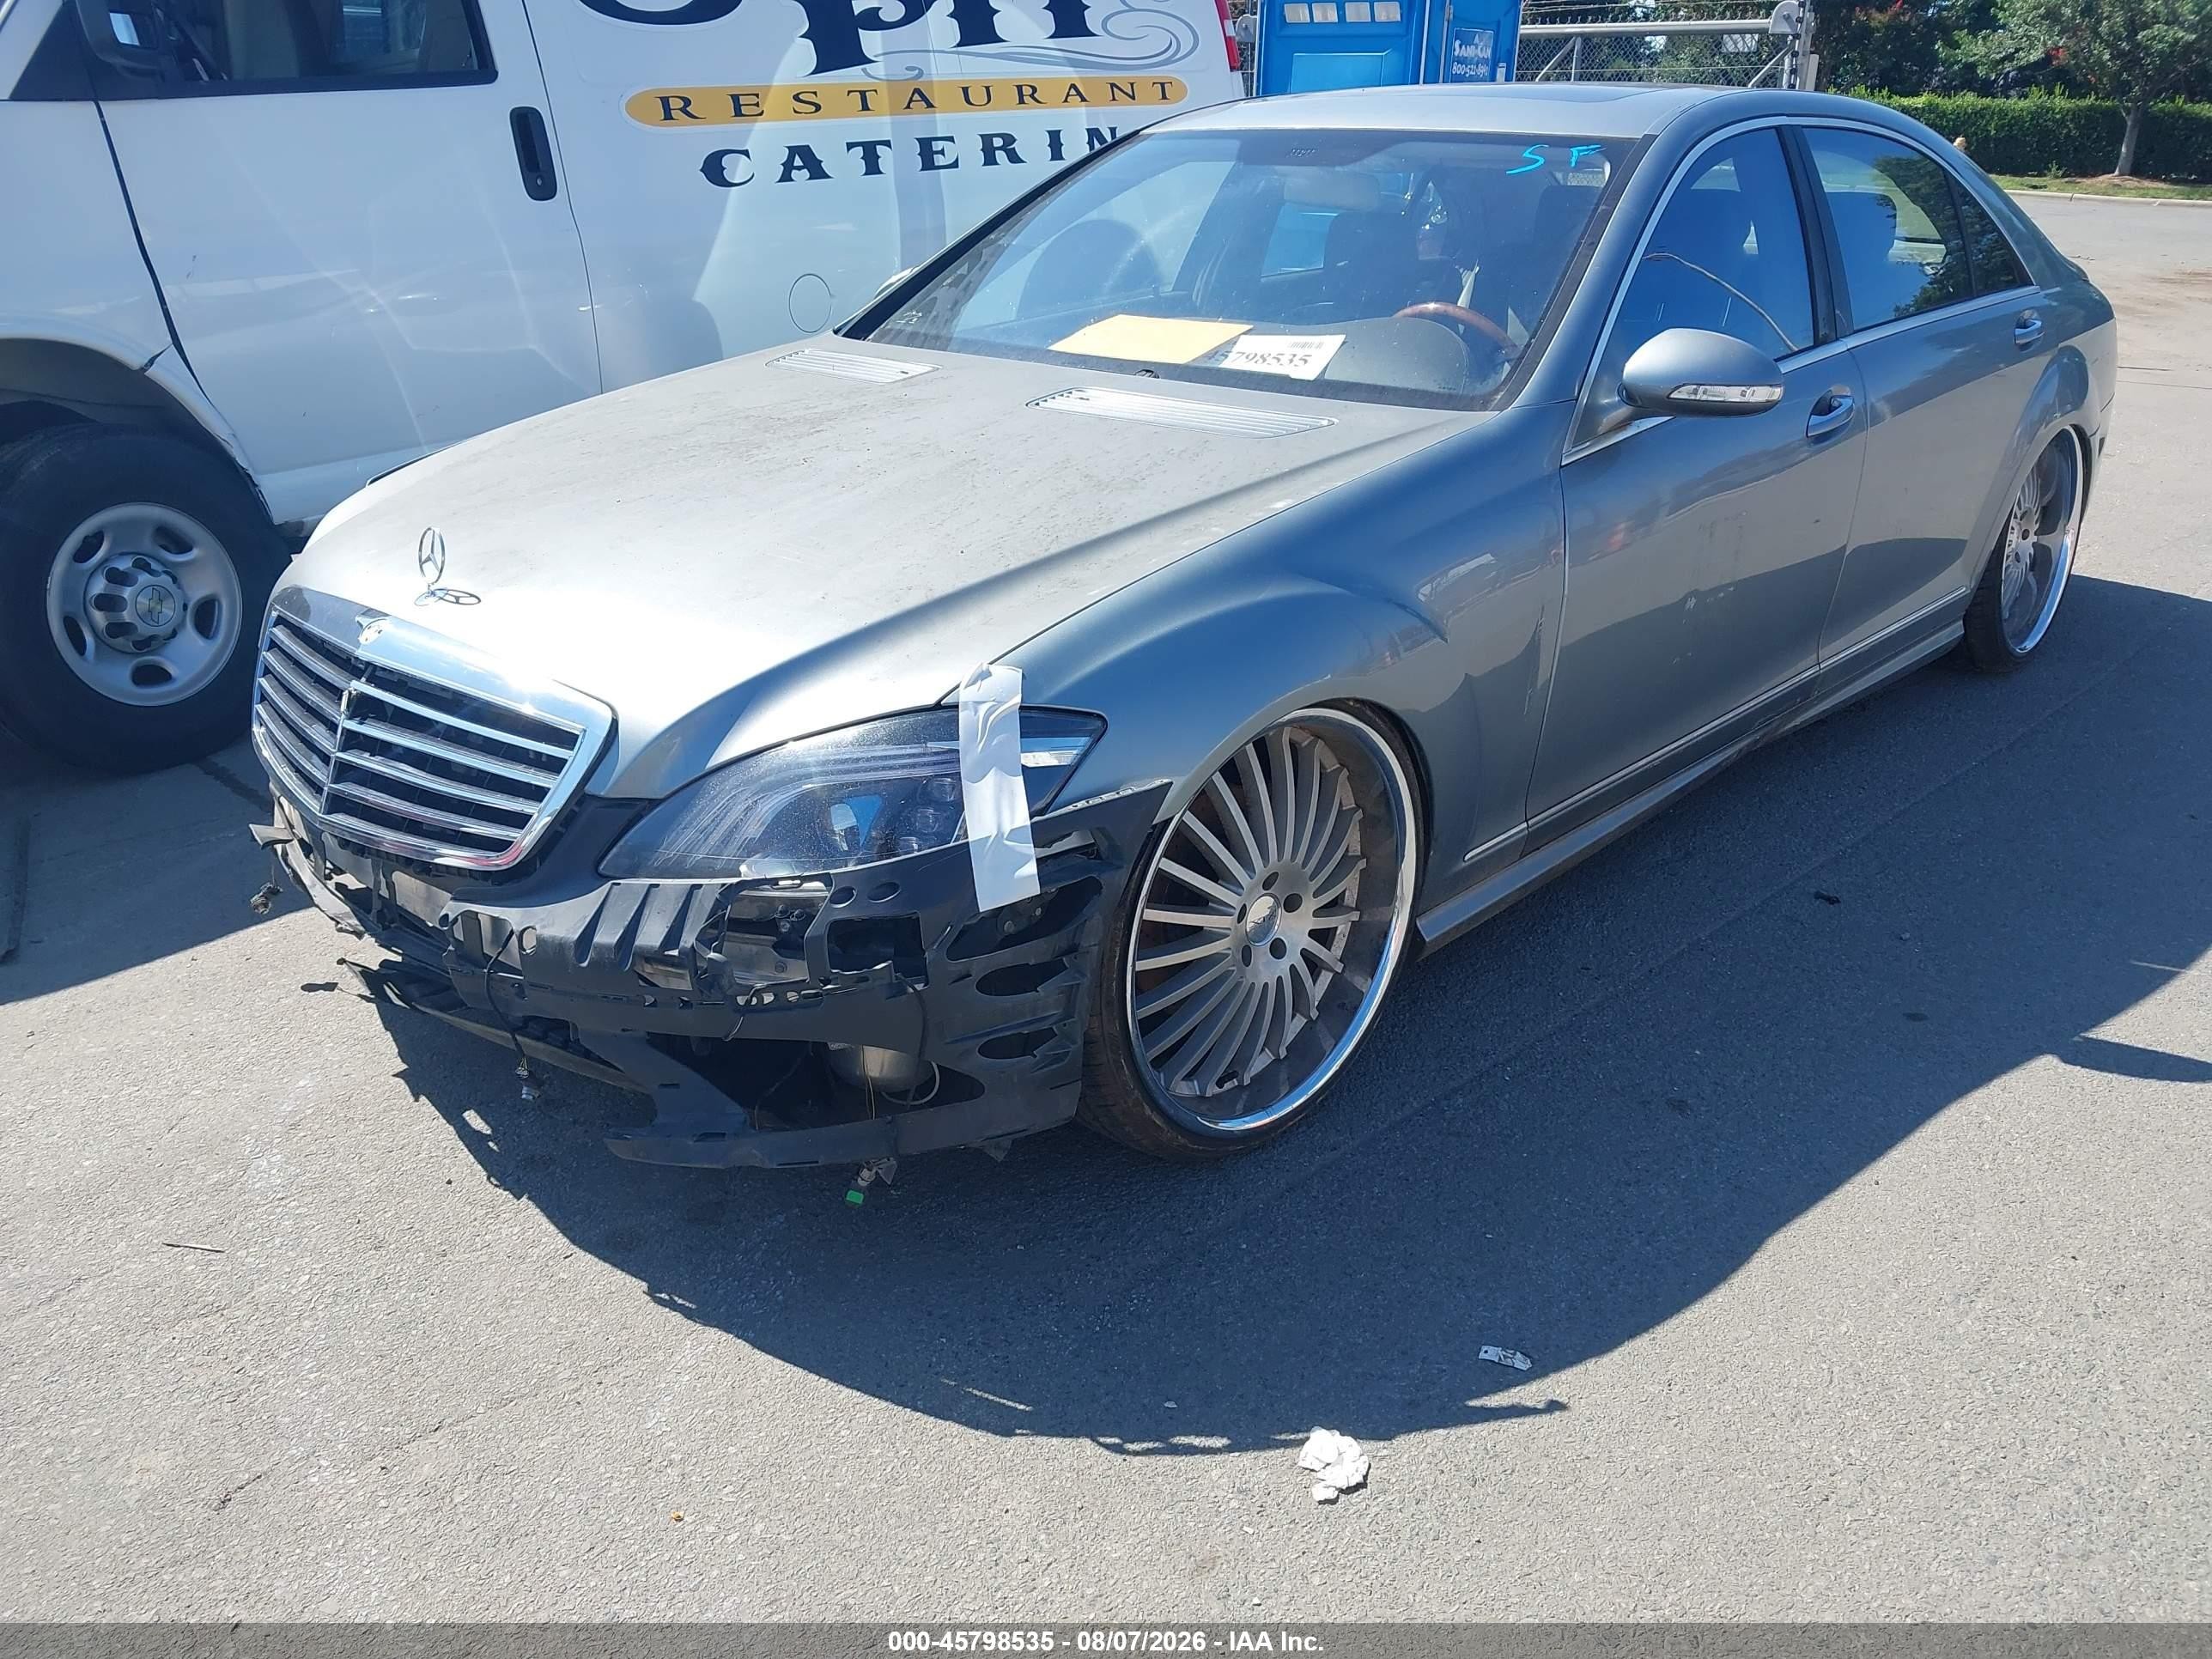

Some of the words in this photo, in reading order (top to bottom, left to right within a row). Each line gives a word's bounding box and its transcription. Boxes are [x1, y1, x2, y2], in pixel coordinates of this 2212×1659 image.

[658, 80, 1176, 122] RESTAURANT
[1506, 144, 1549, 174] S
[1570, 144, 1607, 167] F
